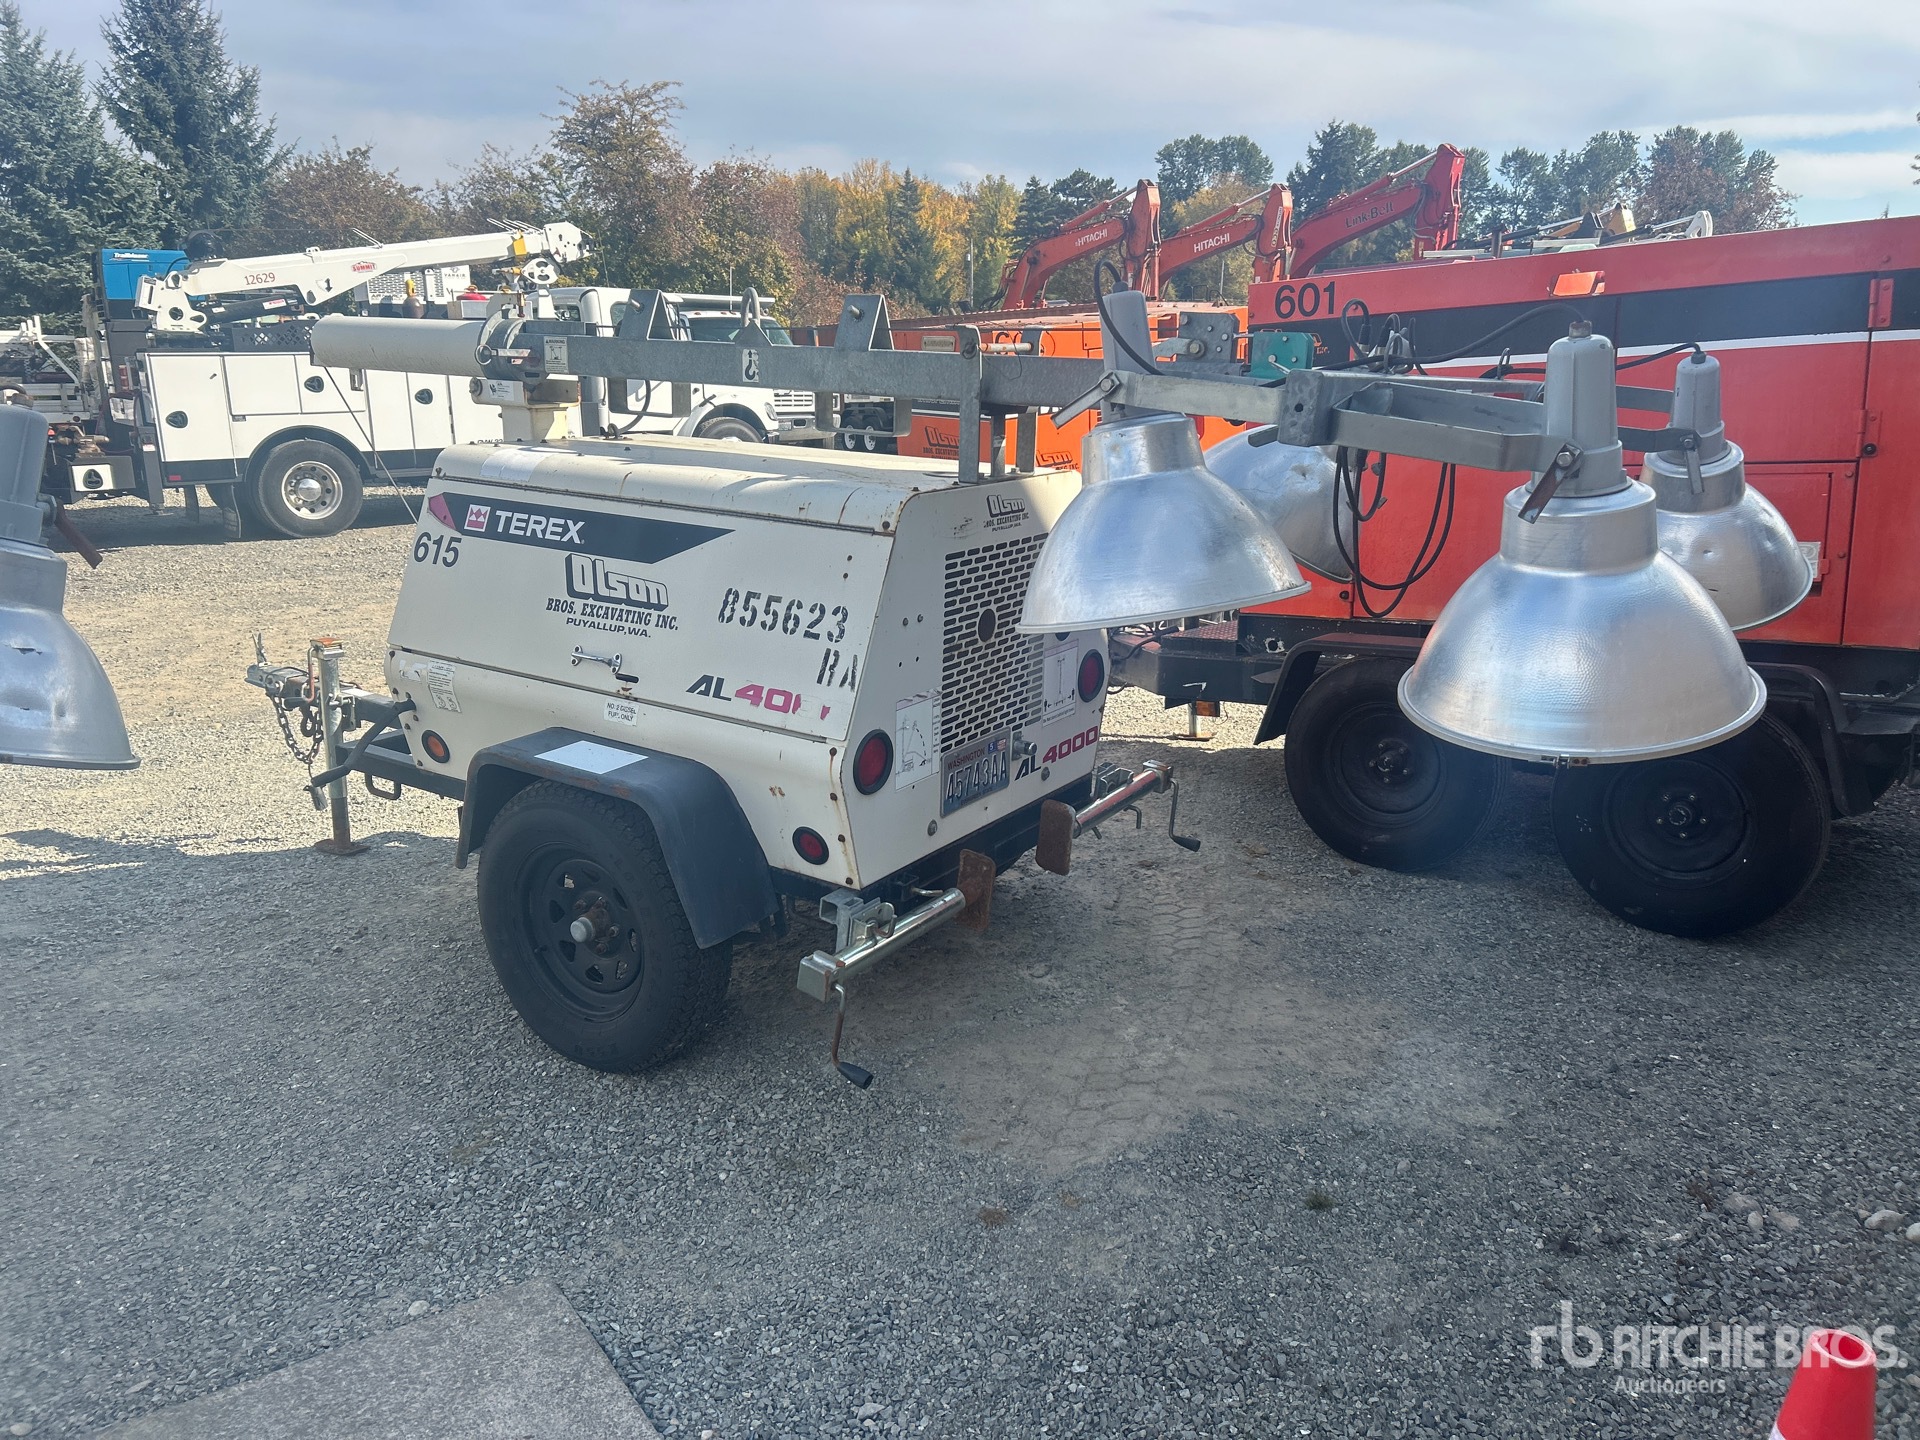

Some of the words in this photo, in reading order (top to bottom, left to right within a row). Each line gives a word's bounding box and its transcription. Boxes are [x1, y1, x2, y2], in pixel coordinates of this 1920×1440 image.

[1077, 228, 1108, 247] HITACHI
[1193, 233, 1231, 253] HITACHI
[245, 272, 276, 286] 12629
[352, 263, 376, 271] SUMMIT
[1275, 281, 1336, 319] 601
[1035, 449, 1073, 467] lson
[986, 494, 1025, 518] Olson
[495, 510, 585, 544] TEREX
[413, 531, 462, 567] 615
[565, 553, 669, 612] Olson
[545, 598, 577, 615] BROS.
[580, 602, 652, 627] EXCAVATING
[655, 614, 679, 631] INC.
[718, 587, 849, 643] 855623
[816, 648, 858, 692] RA
[947, 746, 985, 771] WASHINGTON
[946, 751, 1008, 803] 45743AA
